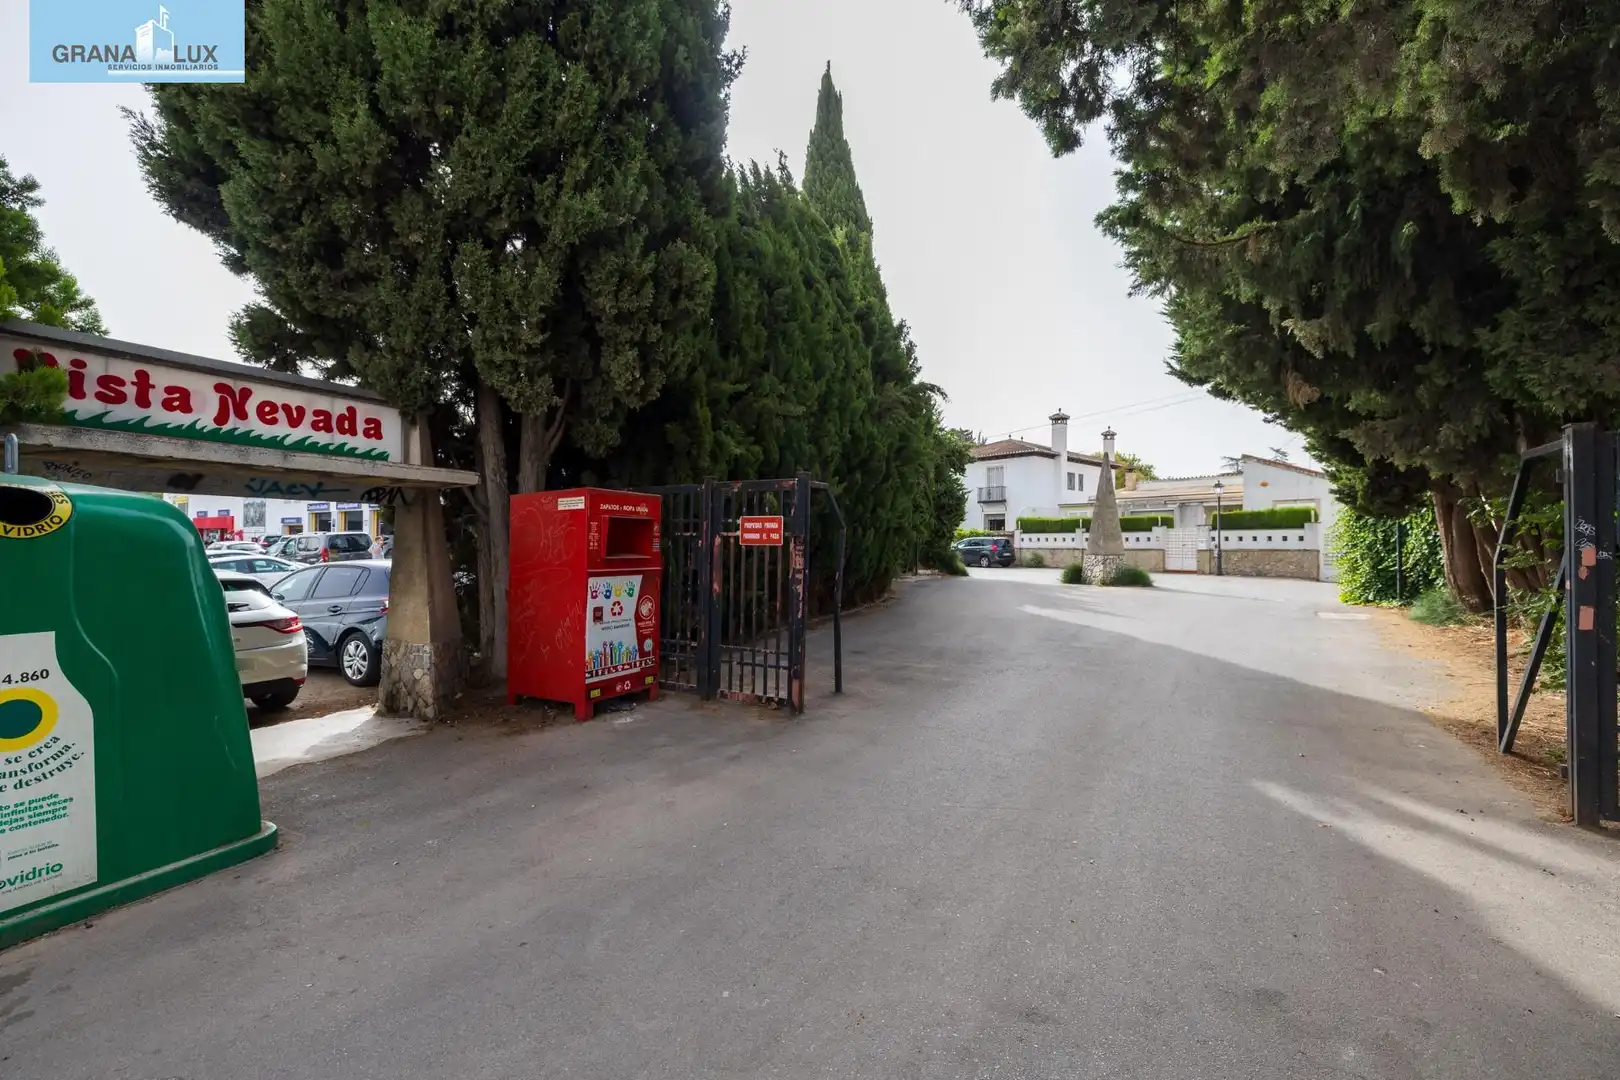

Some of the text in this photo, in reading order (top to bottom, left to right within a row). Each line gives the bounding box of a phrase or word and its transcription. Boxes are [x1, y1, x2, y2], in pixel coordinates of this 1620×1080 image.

[213, 382, 384, 441] Nevada
[3, 515, 64, 536] VIDRIO
[4, 736, 61, 765] se crea
[13, 752, 85, 790] destruye.
[13, 801, 25, 809] se
[28, 793, 59, 806] puede
[46, 797, 74, 808] veces
[9, 812, 69, 832] contenedor.
[27, 805, 68, 819] siempre
